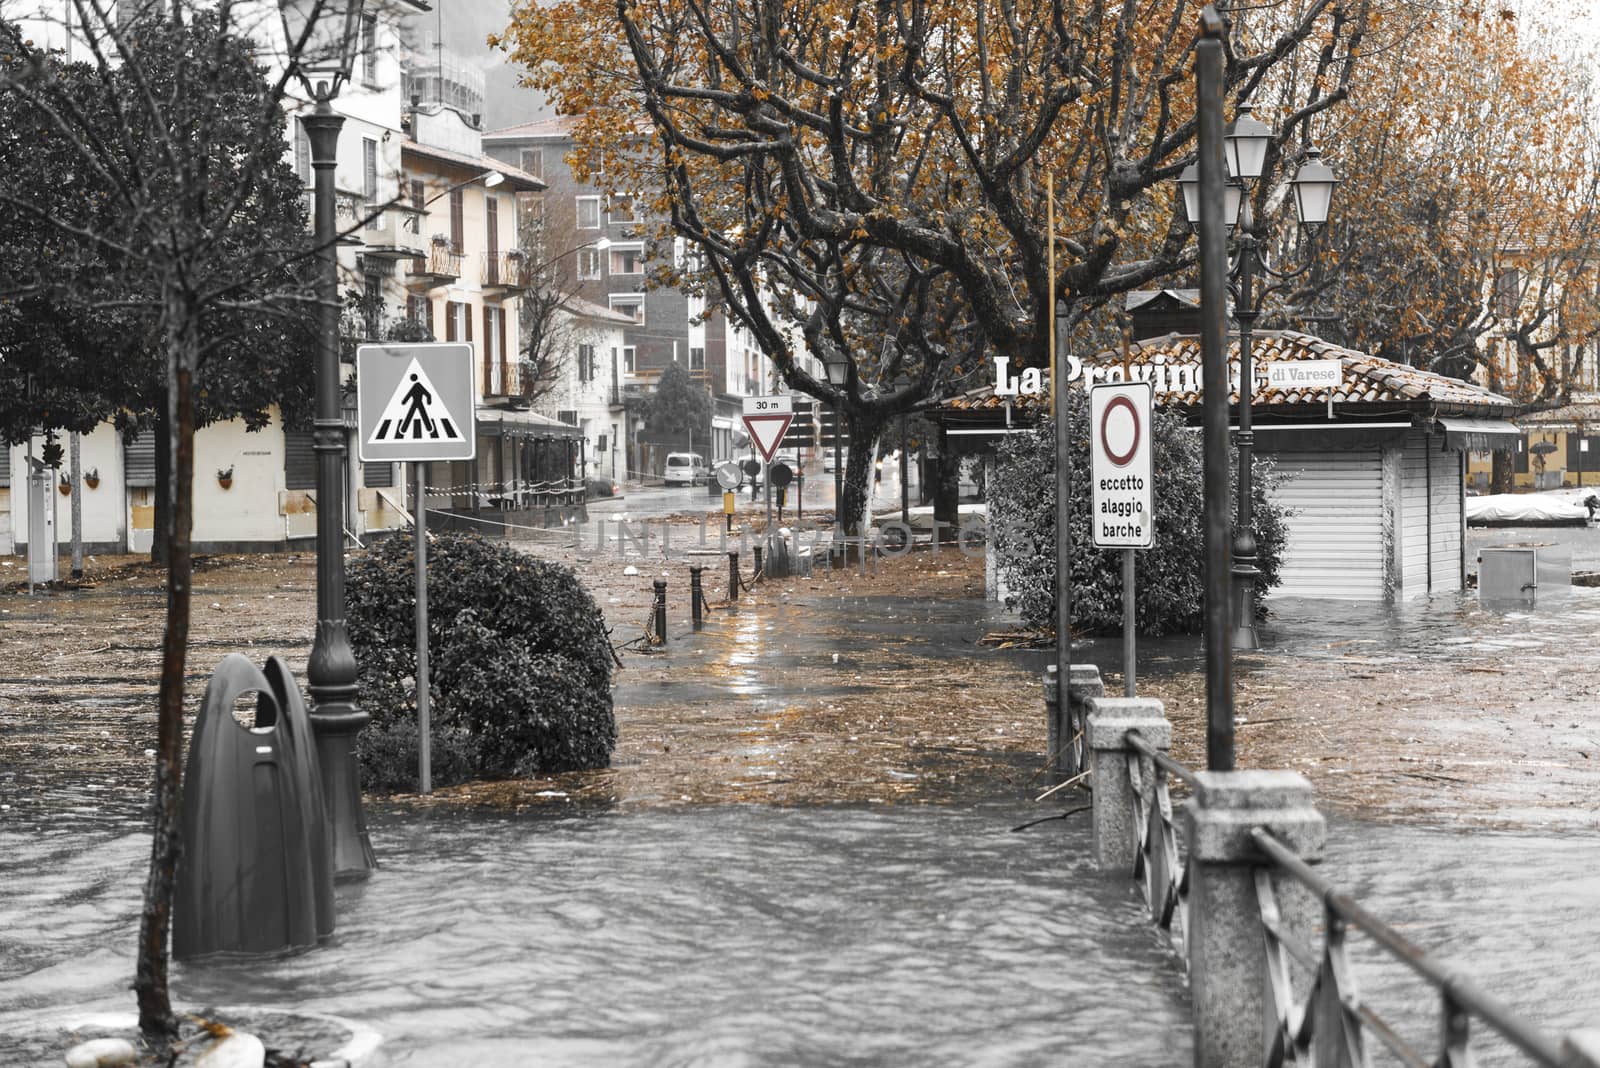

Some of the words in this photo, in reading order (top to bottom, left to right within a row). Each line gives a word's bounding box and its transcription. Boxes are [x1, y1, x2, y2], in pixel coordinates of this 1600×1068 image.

[993, 355, 1041, 395] La
[1066, 354, 1261, 394] rovina
[1272, 368, 1285, 381] di
[1288, 367, 1336, 381] Varese
[756, 401, 768, 410] 30
[1100, 474, 1144, 490] eccetto
[1101, 496, 1143, 517] alaggio
[1103, 521, 1142, 537] barche
